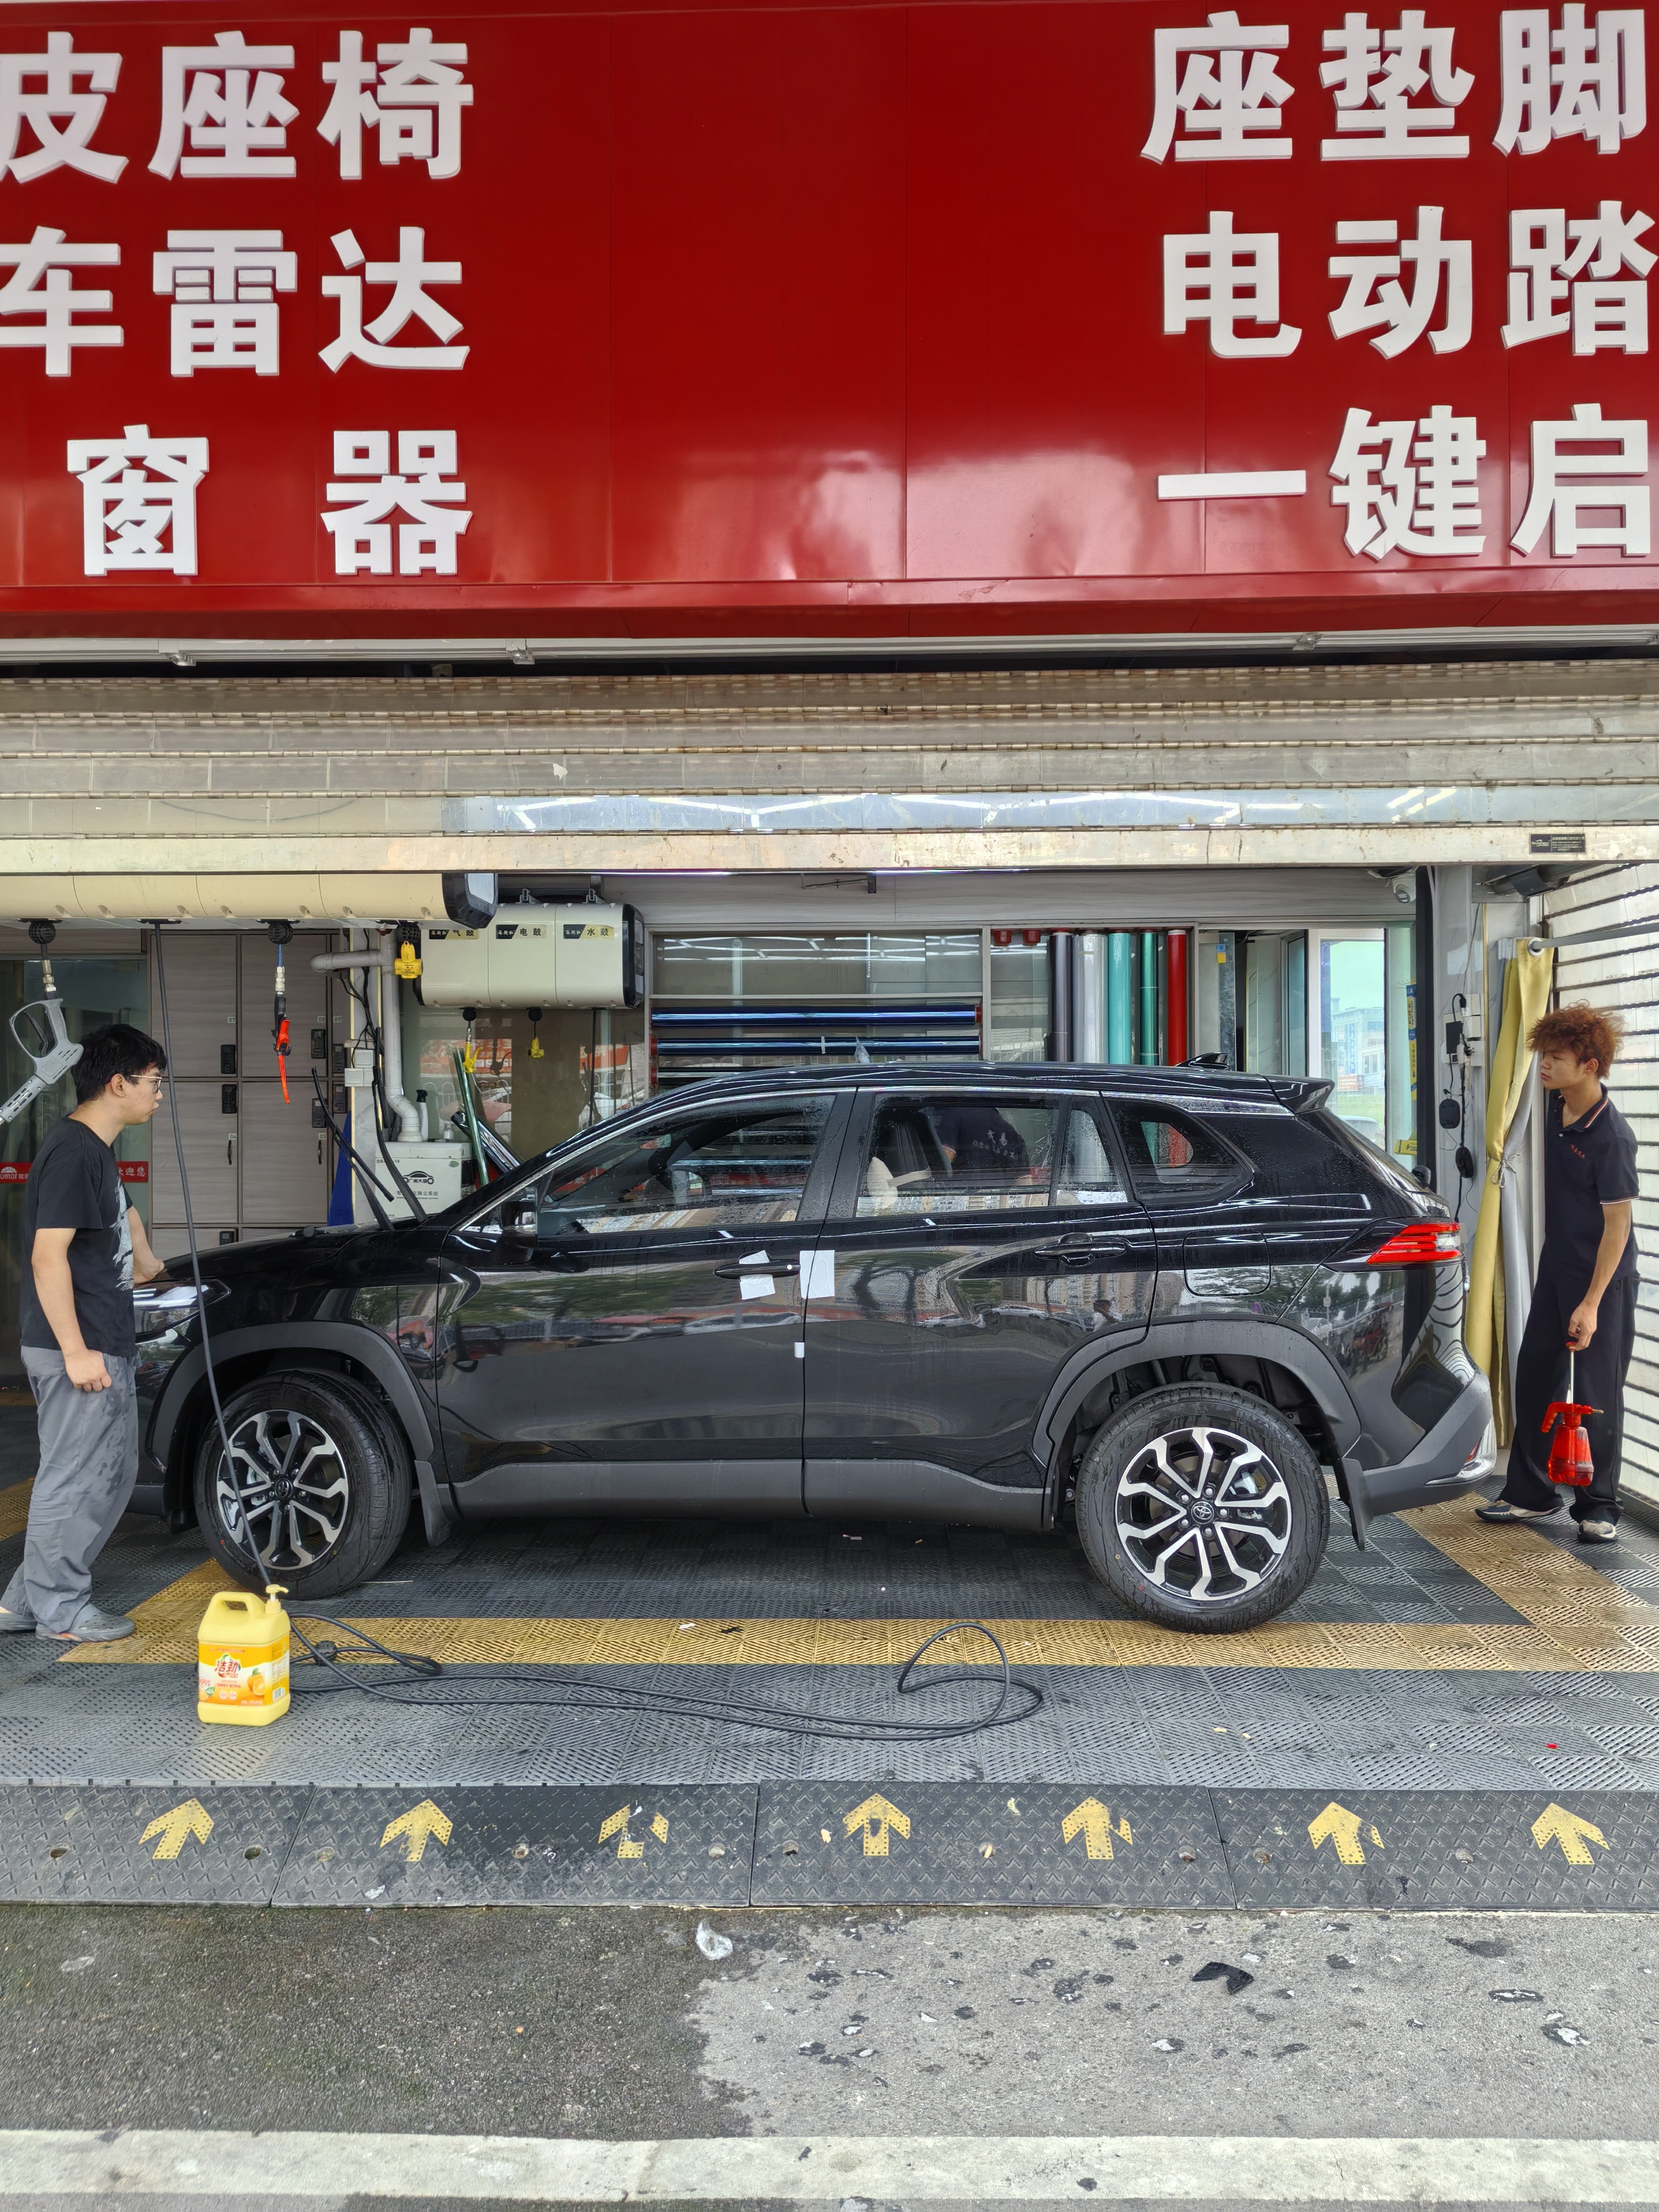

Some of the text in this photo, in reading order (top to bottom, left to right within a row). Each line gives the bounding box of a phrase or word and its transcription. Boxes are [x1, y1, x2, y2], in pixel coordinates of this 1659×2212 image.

[0, 28, 474, 183] 皮座椅
[1141, 3, 1647, 164] 座垫脚
[0, 226, 470, 377] 车雷达
[1163, 200, 1658, 359] 电动踏
[1157, 403, 1650, 561] 一键启
[520, 928, 542, 936] 电鼓
[587, 928, 609, 936] 水鼓
